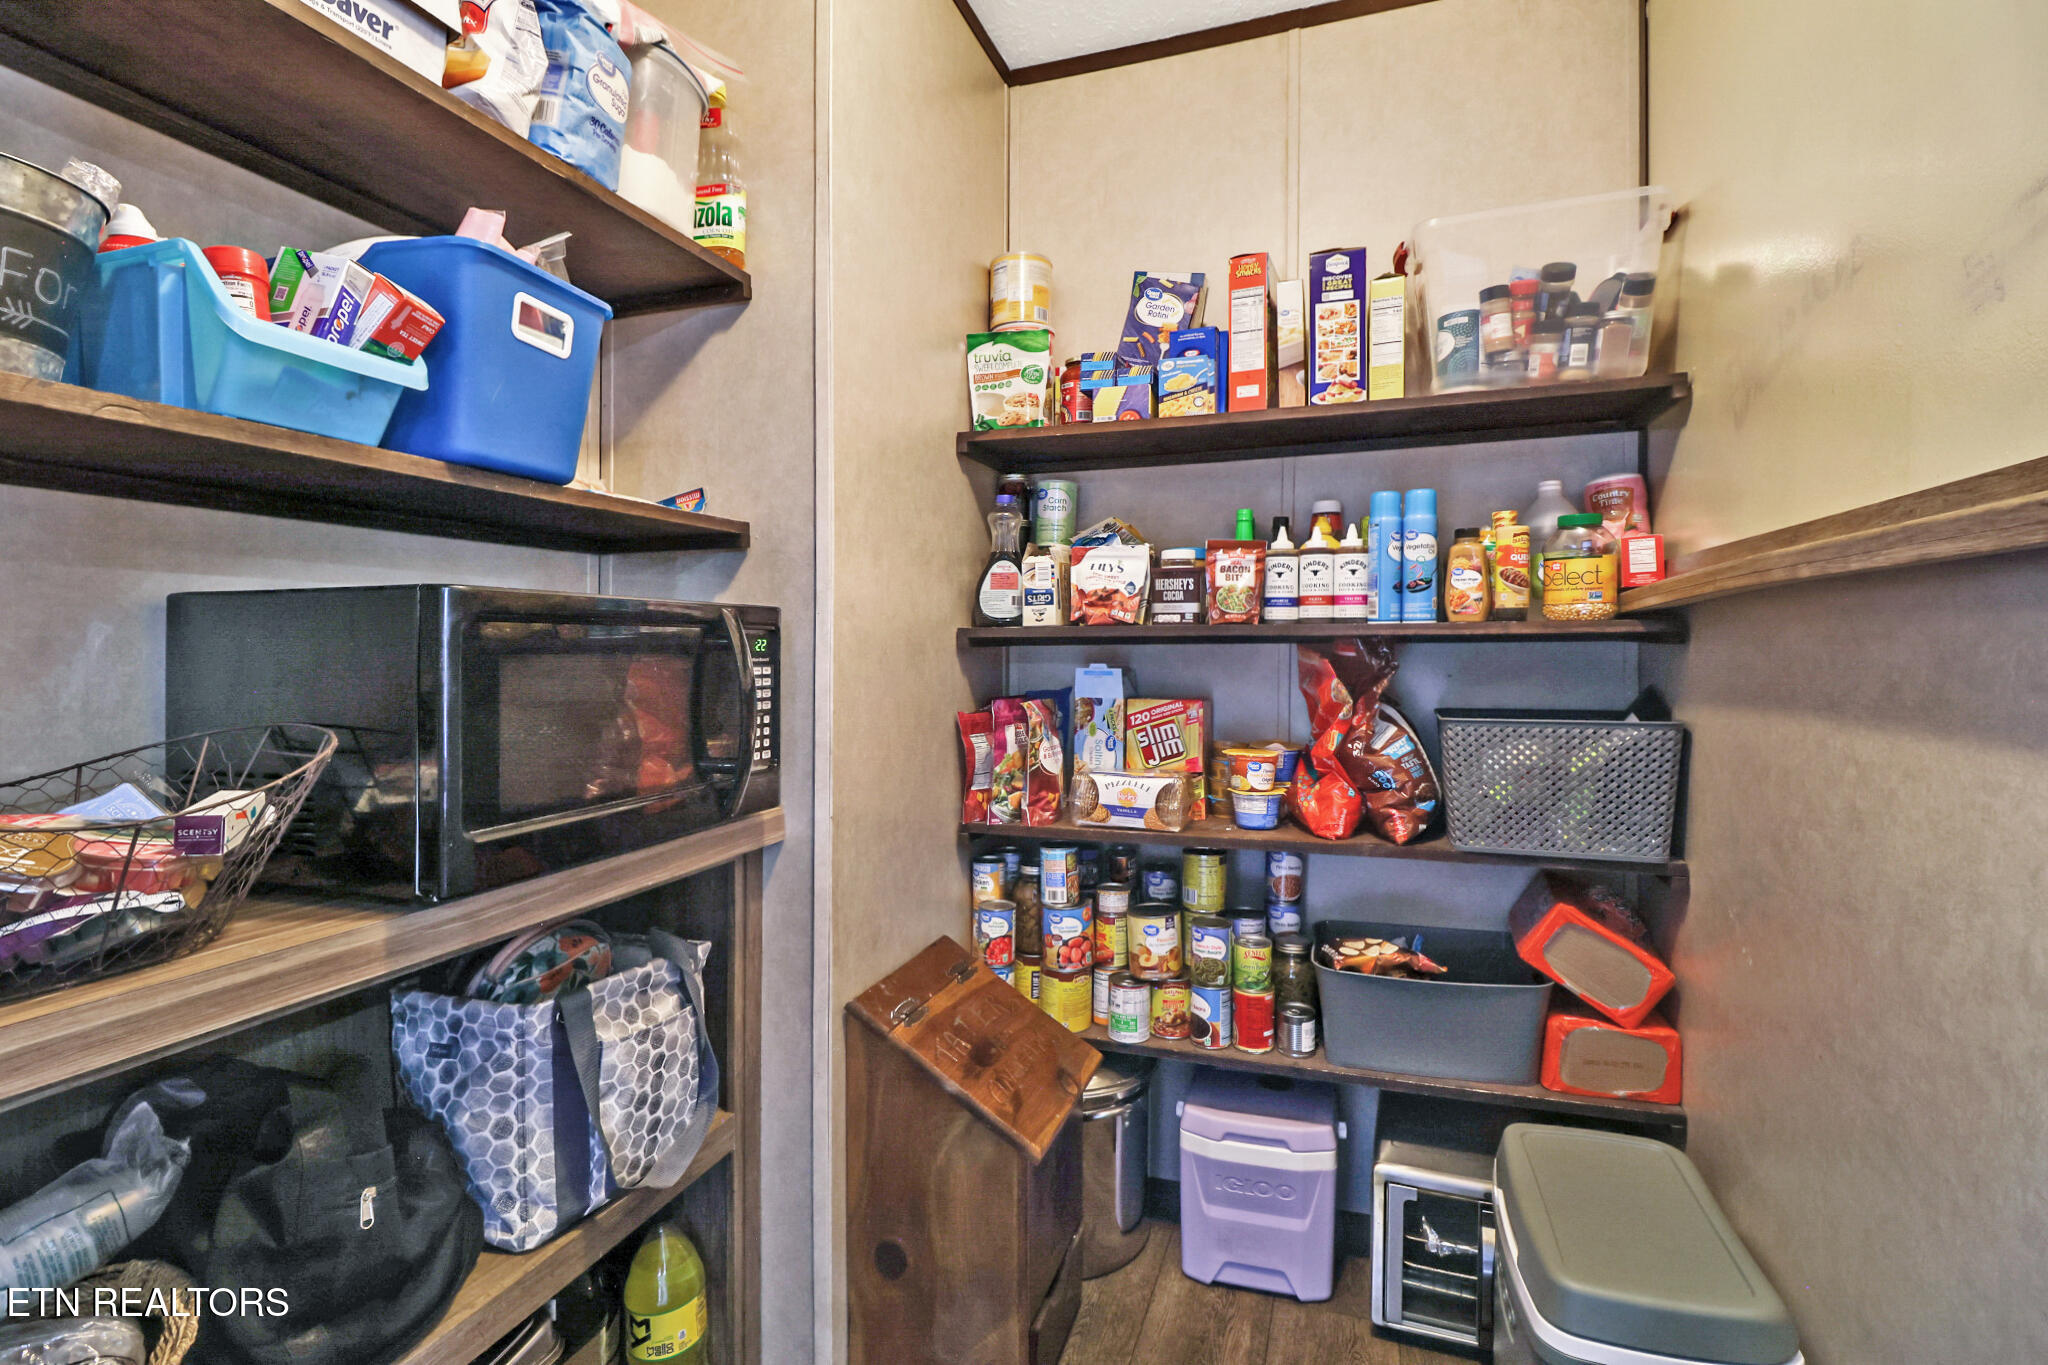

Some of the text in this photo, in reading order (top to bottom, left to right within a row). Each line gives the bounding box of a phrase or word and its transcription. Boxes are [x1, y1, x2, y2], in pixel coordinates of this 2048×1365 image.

[1145, 301, 1176, 313] Garden
[326, 291, 355, 343] propel
[1147, 309, 1169, 319] Rotini
[974, 350, 1012, 364] truvia
[1047, 496, 1067, 505] Corn
[1592, 489, 1630, 502] Country
[1042, 504, 1067, 512] Starch
[1598, 497, 1624, 508] Time
[1405, 543, 1436, 551] Vegetable
[1510, 553, 1529, 561] QUE
[1219, 564, 1251, 574] BACON
[1543, 562, 1604, 587] Select
[1155, 577, 1195, 591] HERSHEY'S
[1027, 594, 1052, 604] GRITS
[1162, 590, 1185, 601] COCOA
[1129, 701, 1184, 726] 120 ORIGINAL
[177, 827, 219, 837] SCENTSY
[1214, 1173, 1298, 1201] IGLOO
